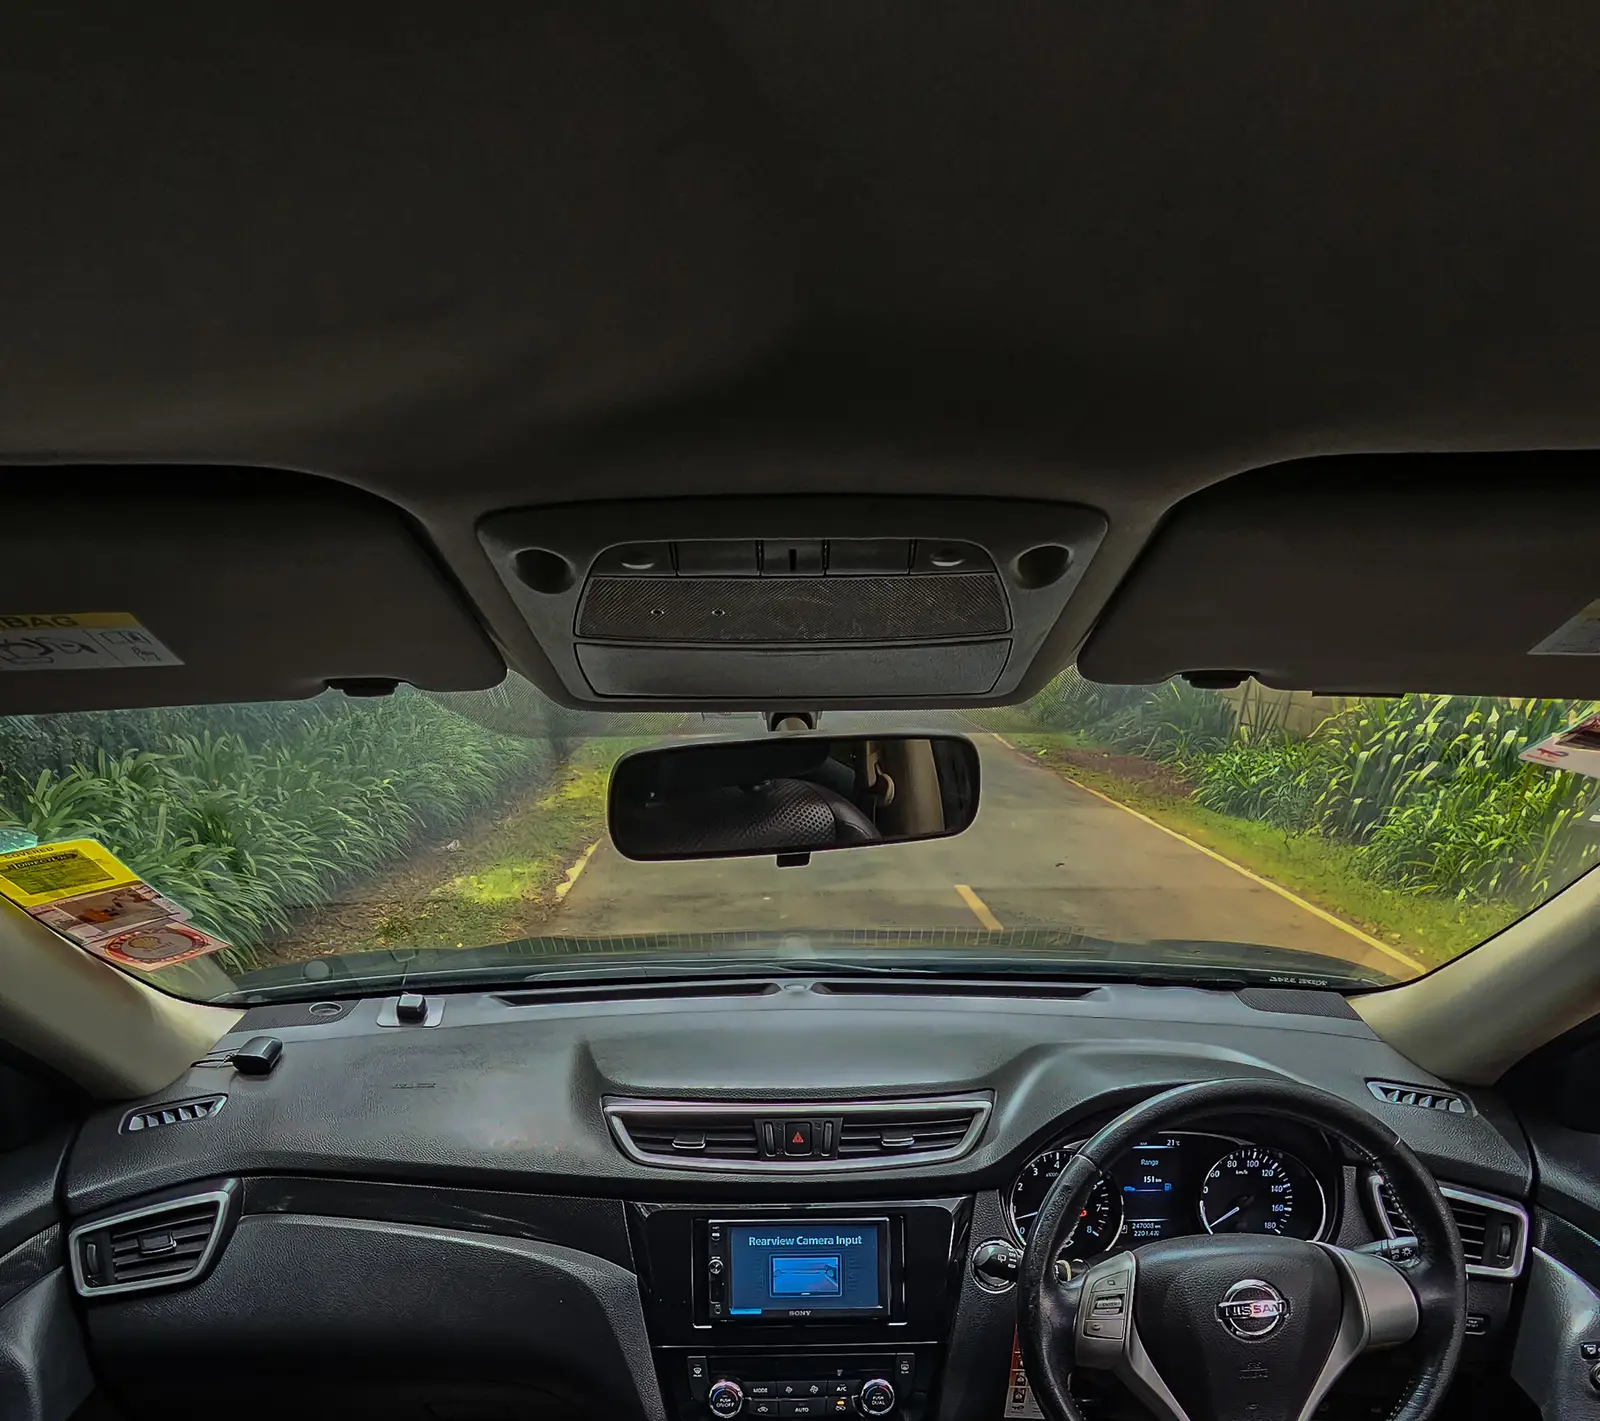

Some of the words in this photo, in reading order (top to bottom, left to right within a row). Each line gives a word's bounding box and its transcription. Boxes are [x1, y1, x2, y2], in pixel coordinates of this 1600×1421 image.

[0, 616, 78, 628] BAG
[1054, 1161, 1060, 1169] 4
[1226, 1160, 1237, 1168] 80
[1246, 1160, 1260, 1168] 100
[1033, 1168, 1038, 1176] 3
[1261, 1169, 1274, 1177] 120
[1017, 1183, 1023, 1191] 2
[1270, 1185, 1283, 1193] 140
[1096, 1204, 1102, 1212] 7
[1271, 1204, 1284, 1212] 160
[1264, 1221, 1276, 1229] 180
[748, 1235, 795, 1246] Rearview
[796, 1235, 834, 1245] Camera
[836, 1235, 863, 1247] Input
[1224, 1301, 1284, 1317] NISSAN
